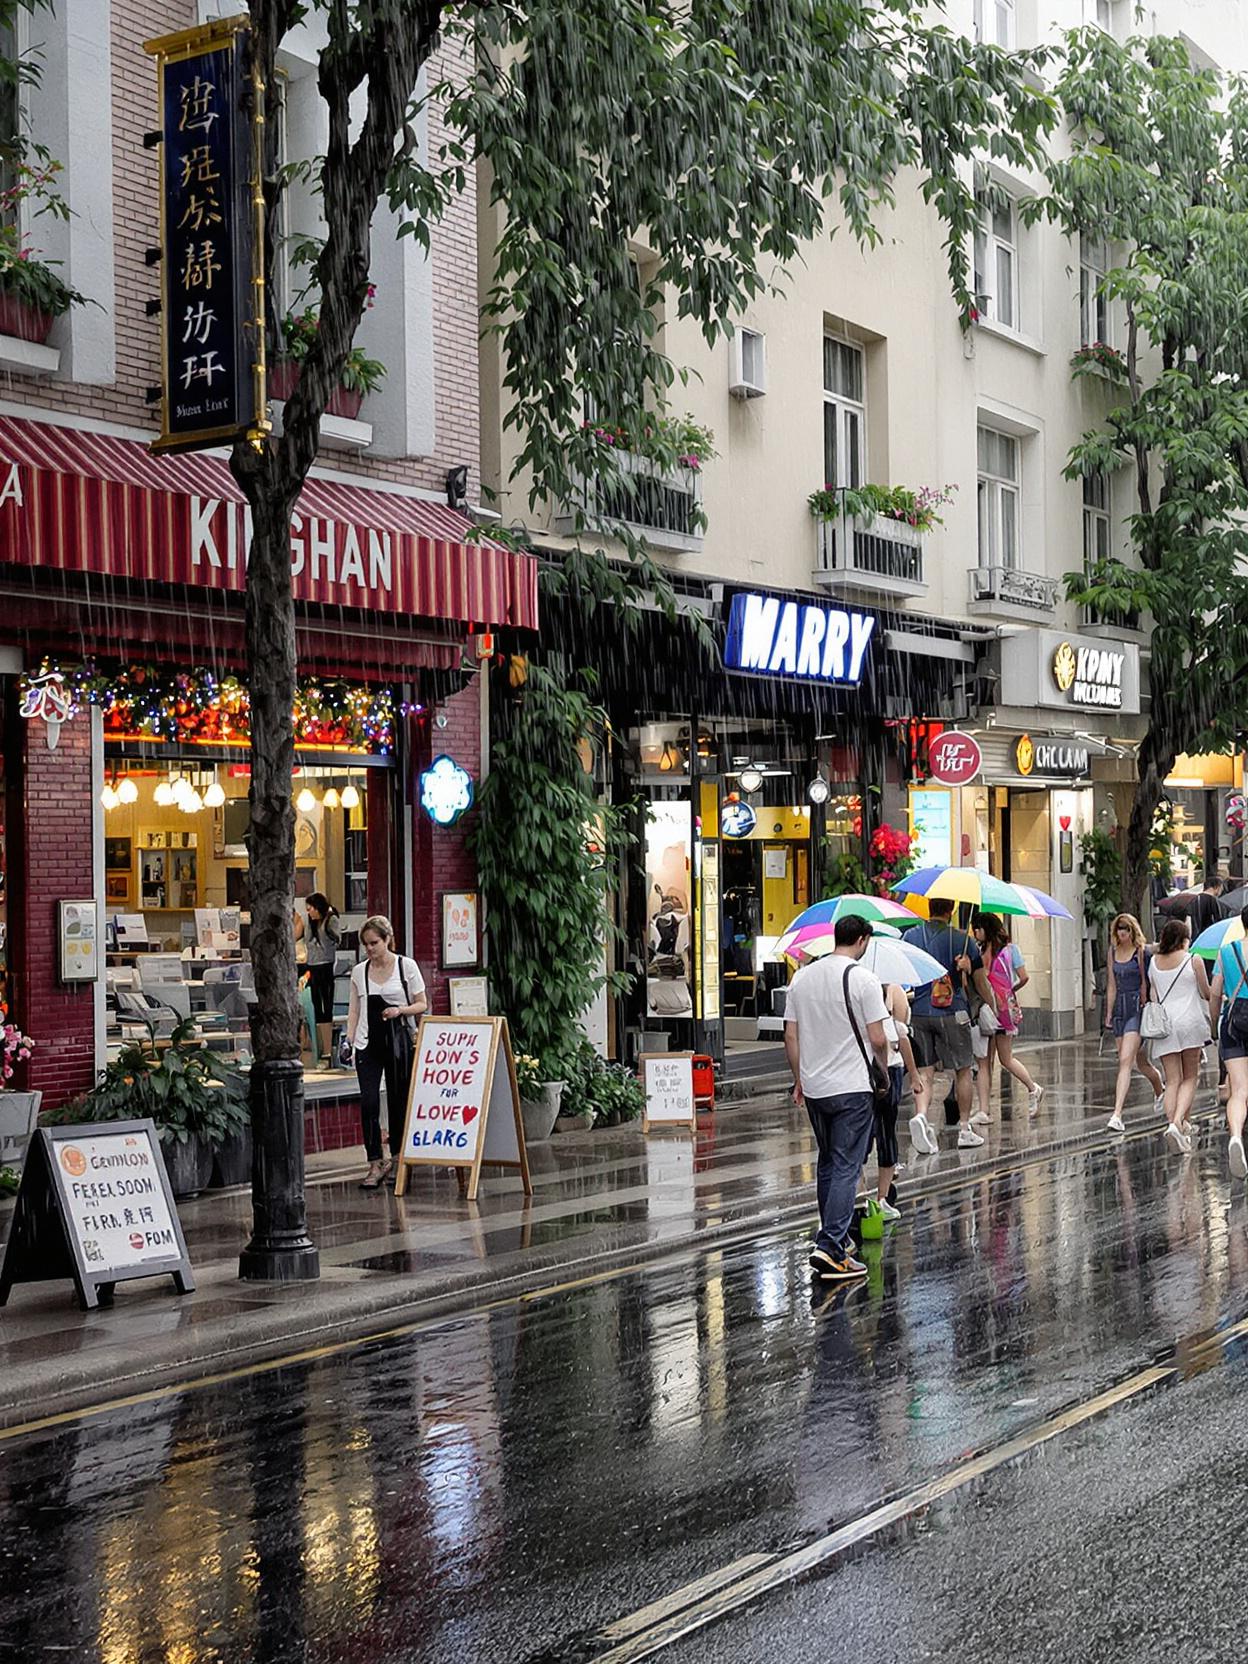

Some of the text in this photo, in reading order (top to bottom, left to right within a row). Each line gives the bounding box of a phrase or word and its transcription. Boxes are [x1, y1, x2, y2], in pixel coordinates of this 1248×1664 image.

[740, 594, 875, 681] MARRY
[423, 1067, 474, 1085] HOVE
[416, 1104, 461, 1121] LOVE
